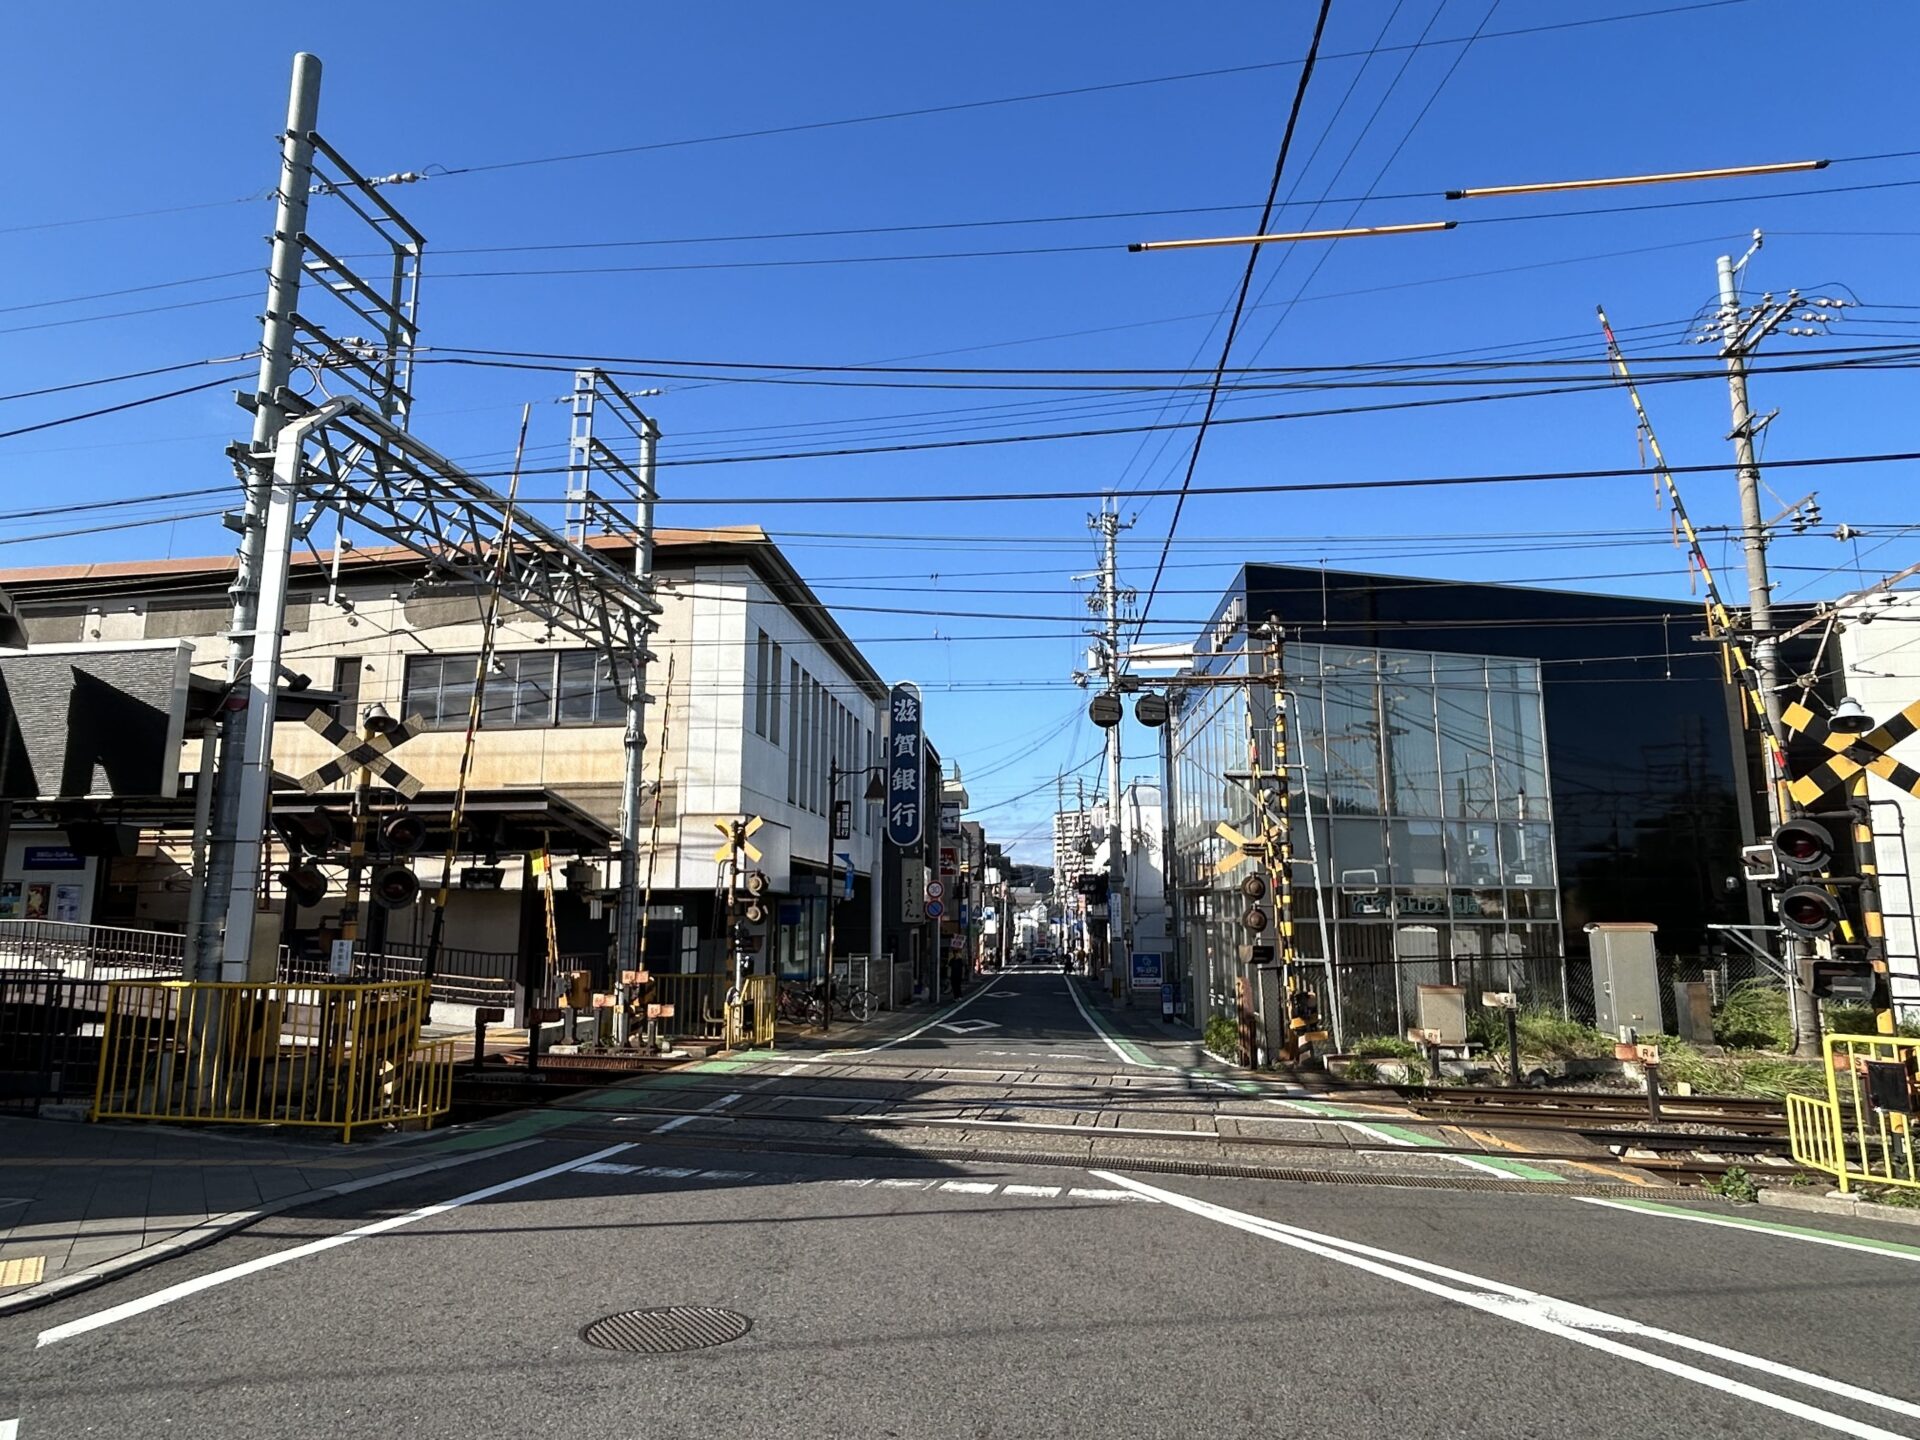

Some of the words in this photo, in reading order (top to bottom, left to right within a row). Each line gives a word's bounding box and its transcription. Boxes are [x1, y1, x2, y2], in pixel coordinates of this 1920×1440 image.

[891, 698, 917, 828] 滋賀銀行
[931, 885, 940, 894] 30
